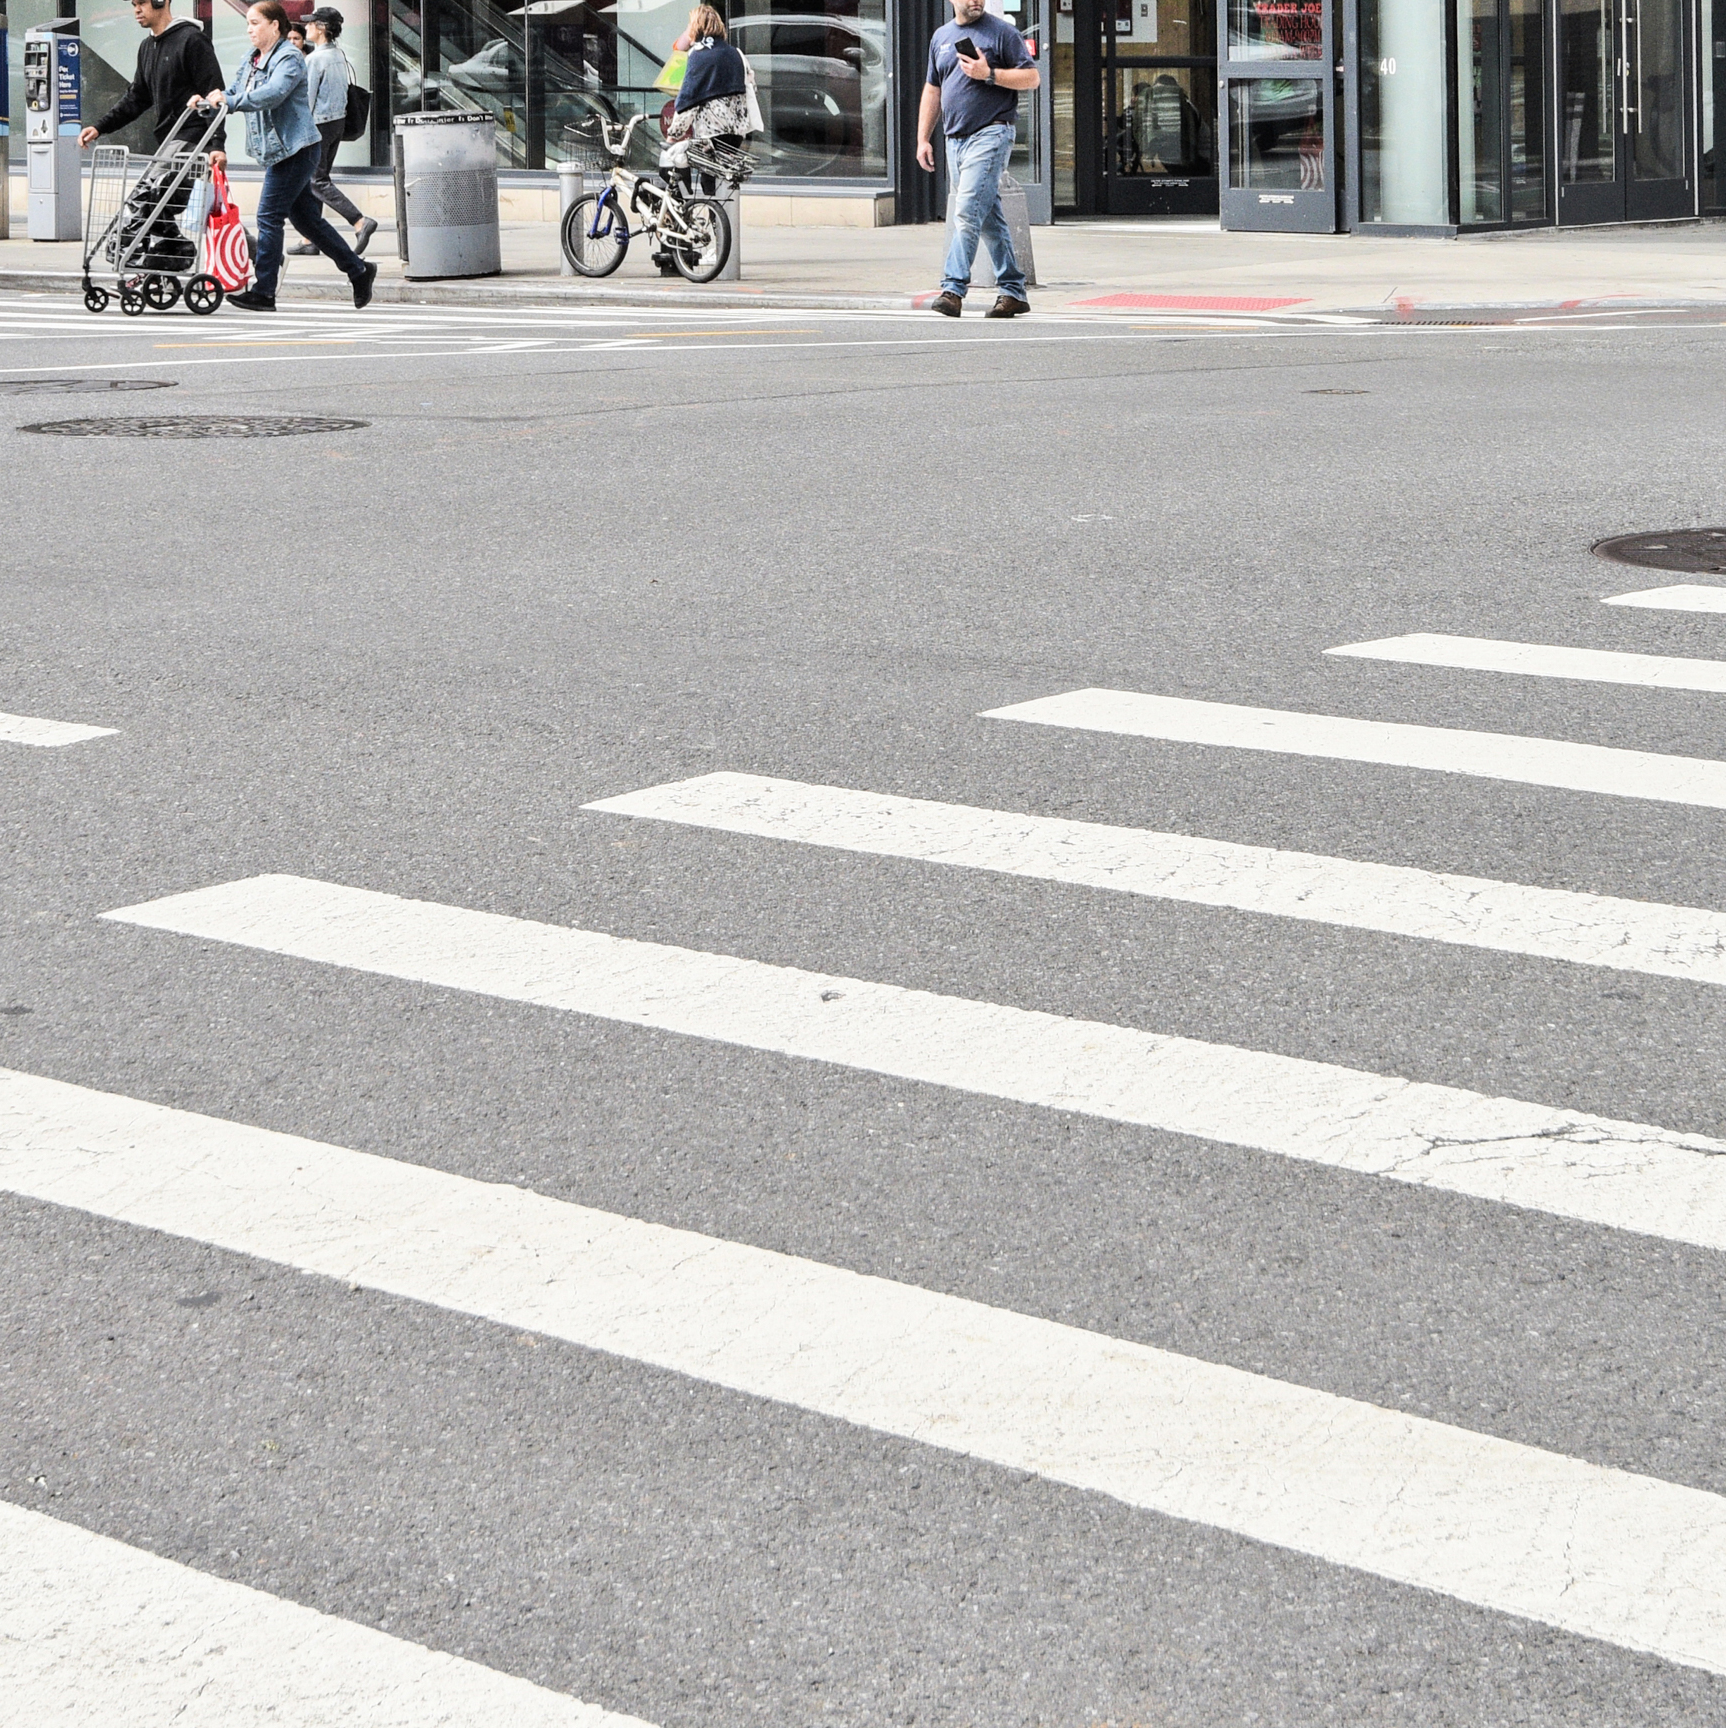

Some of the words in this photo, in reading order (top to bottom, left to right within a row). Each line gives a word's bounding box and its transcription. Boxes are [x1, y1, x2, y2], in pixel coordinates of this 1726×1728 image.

[1256, 2, 1298, 14] TRADER
[1301, 3, 1322, 13] JOE
[1380, 57, 1396, 75] 40
